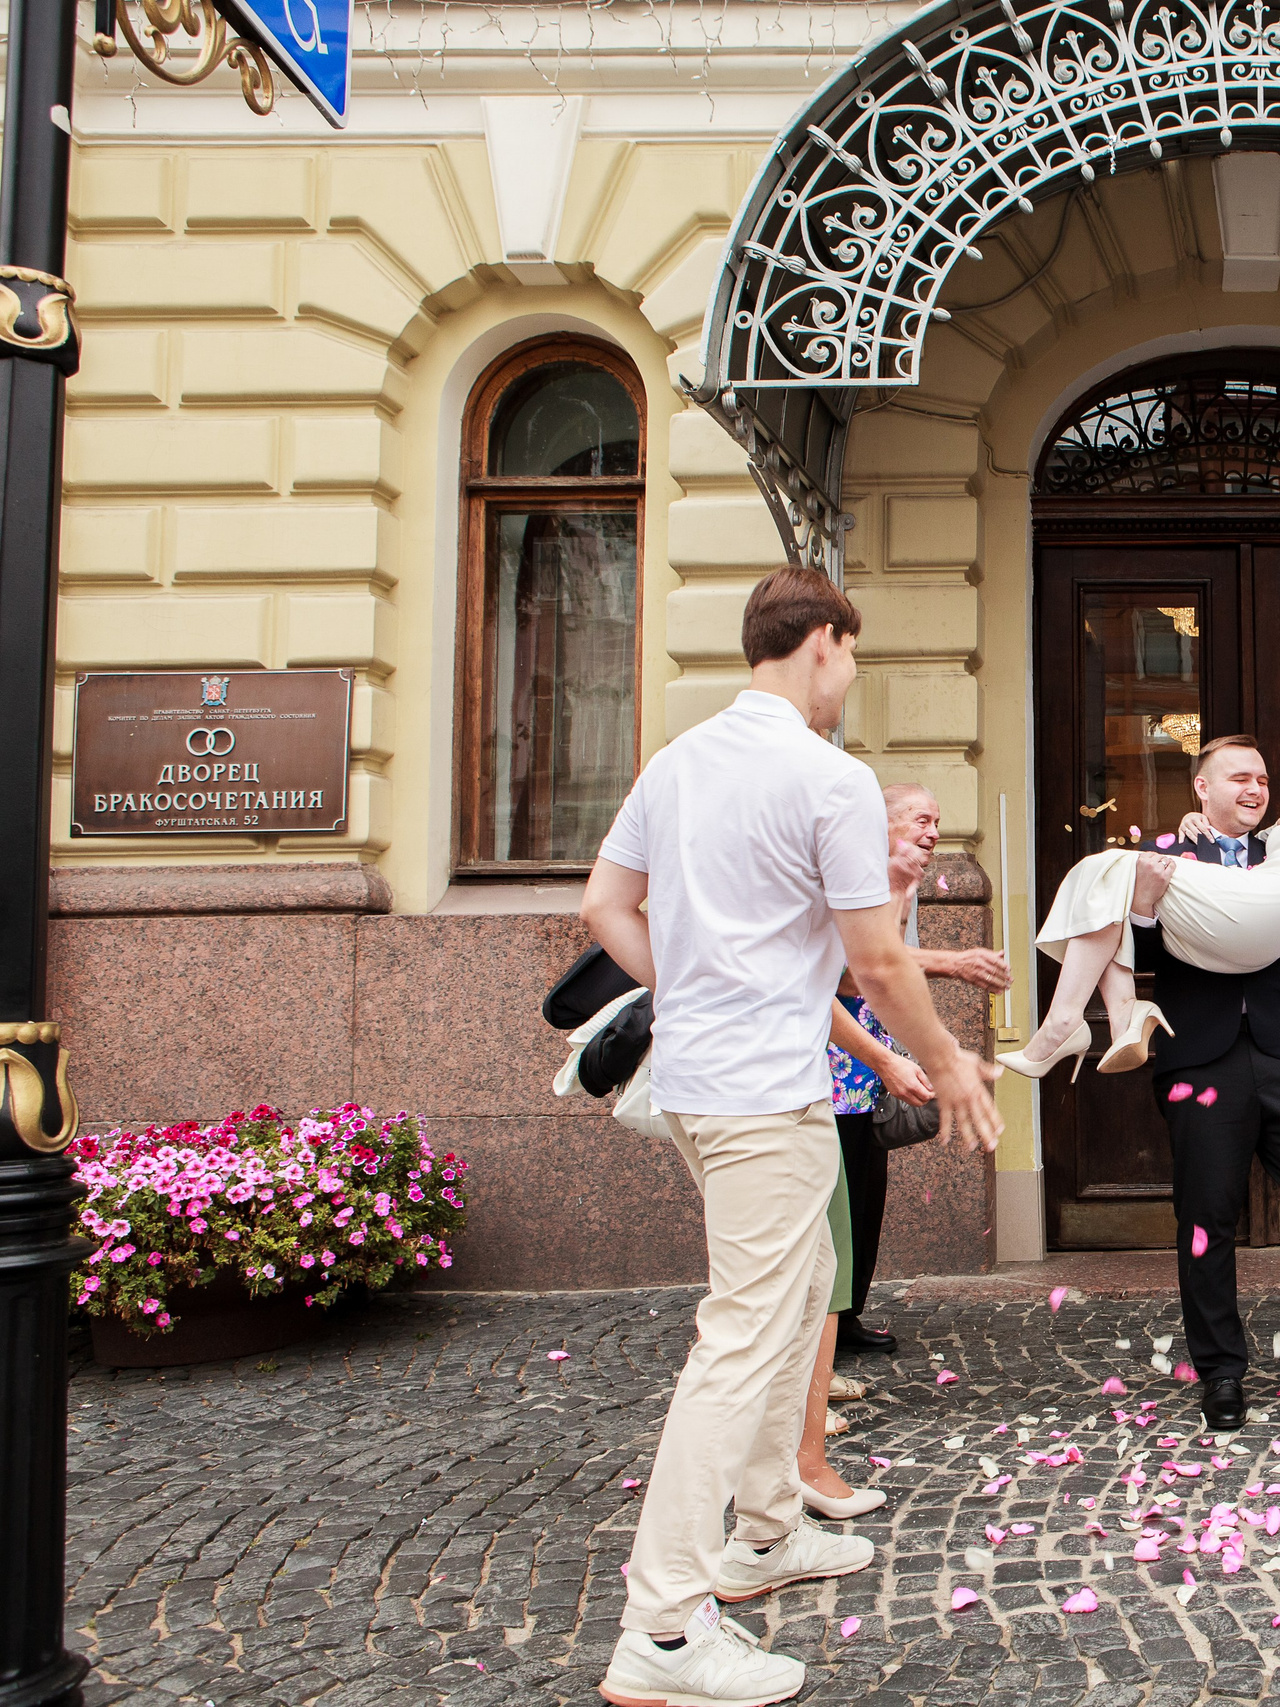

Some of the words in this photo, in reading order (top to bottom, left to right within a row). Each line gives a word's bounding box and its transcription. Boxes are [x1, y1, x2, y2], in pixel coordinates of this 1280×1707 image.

[157, 763, 260, 785] ДВОРЕЦ
[93, 790, 324, 813] БРАКОСОЧЕТАНИЯ
[243, 815, 259, 825] 52
